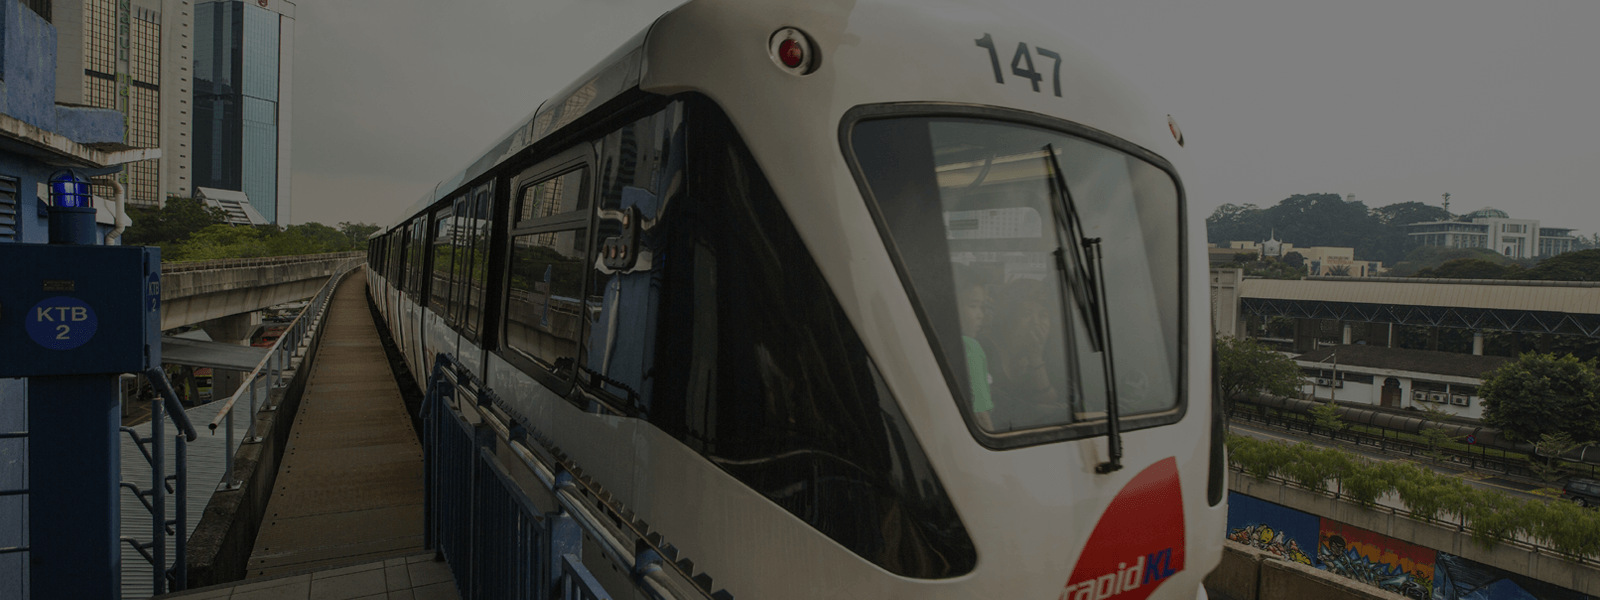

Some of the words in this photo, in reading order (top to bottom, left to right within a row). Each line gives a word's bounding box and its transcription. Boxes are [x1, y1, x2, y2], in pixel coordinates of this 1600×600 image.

[974, 32, 1062, 98] 147
[149, 281, 160, 296] KTB
[152, 298, 157, 312] 2
[37, 306, 88, 322] KTB
[56, 324, 70, 340] 2
